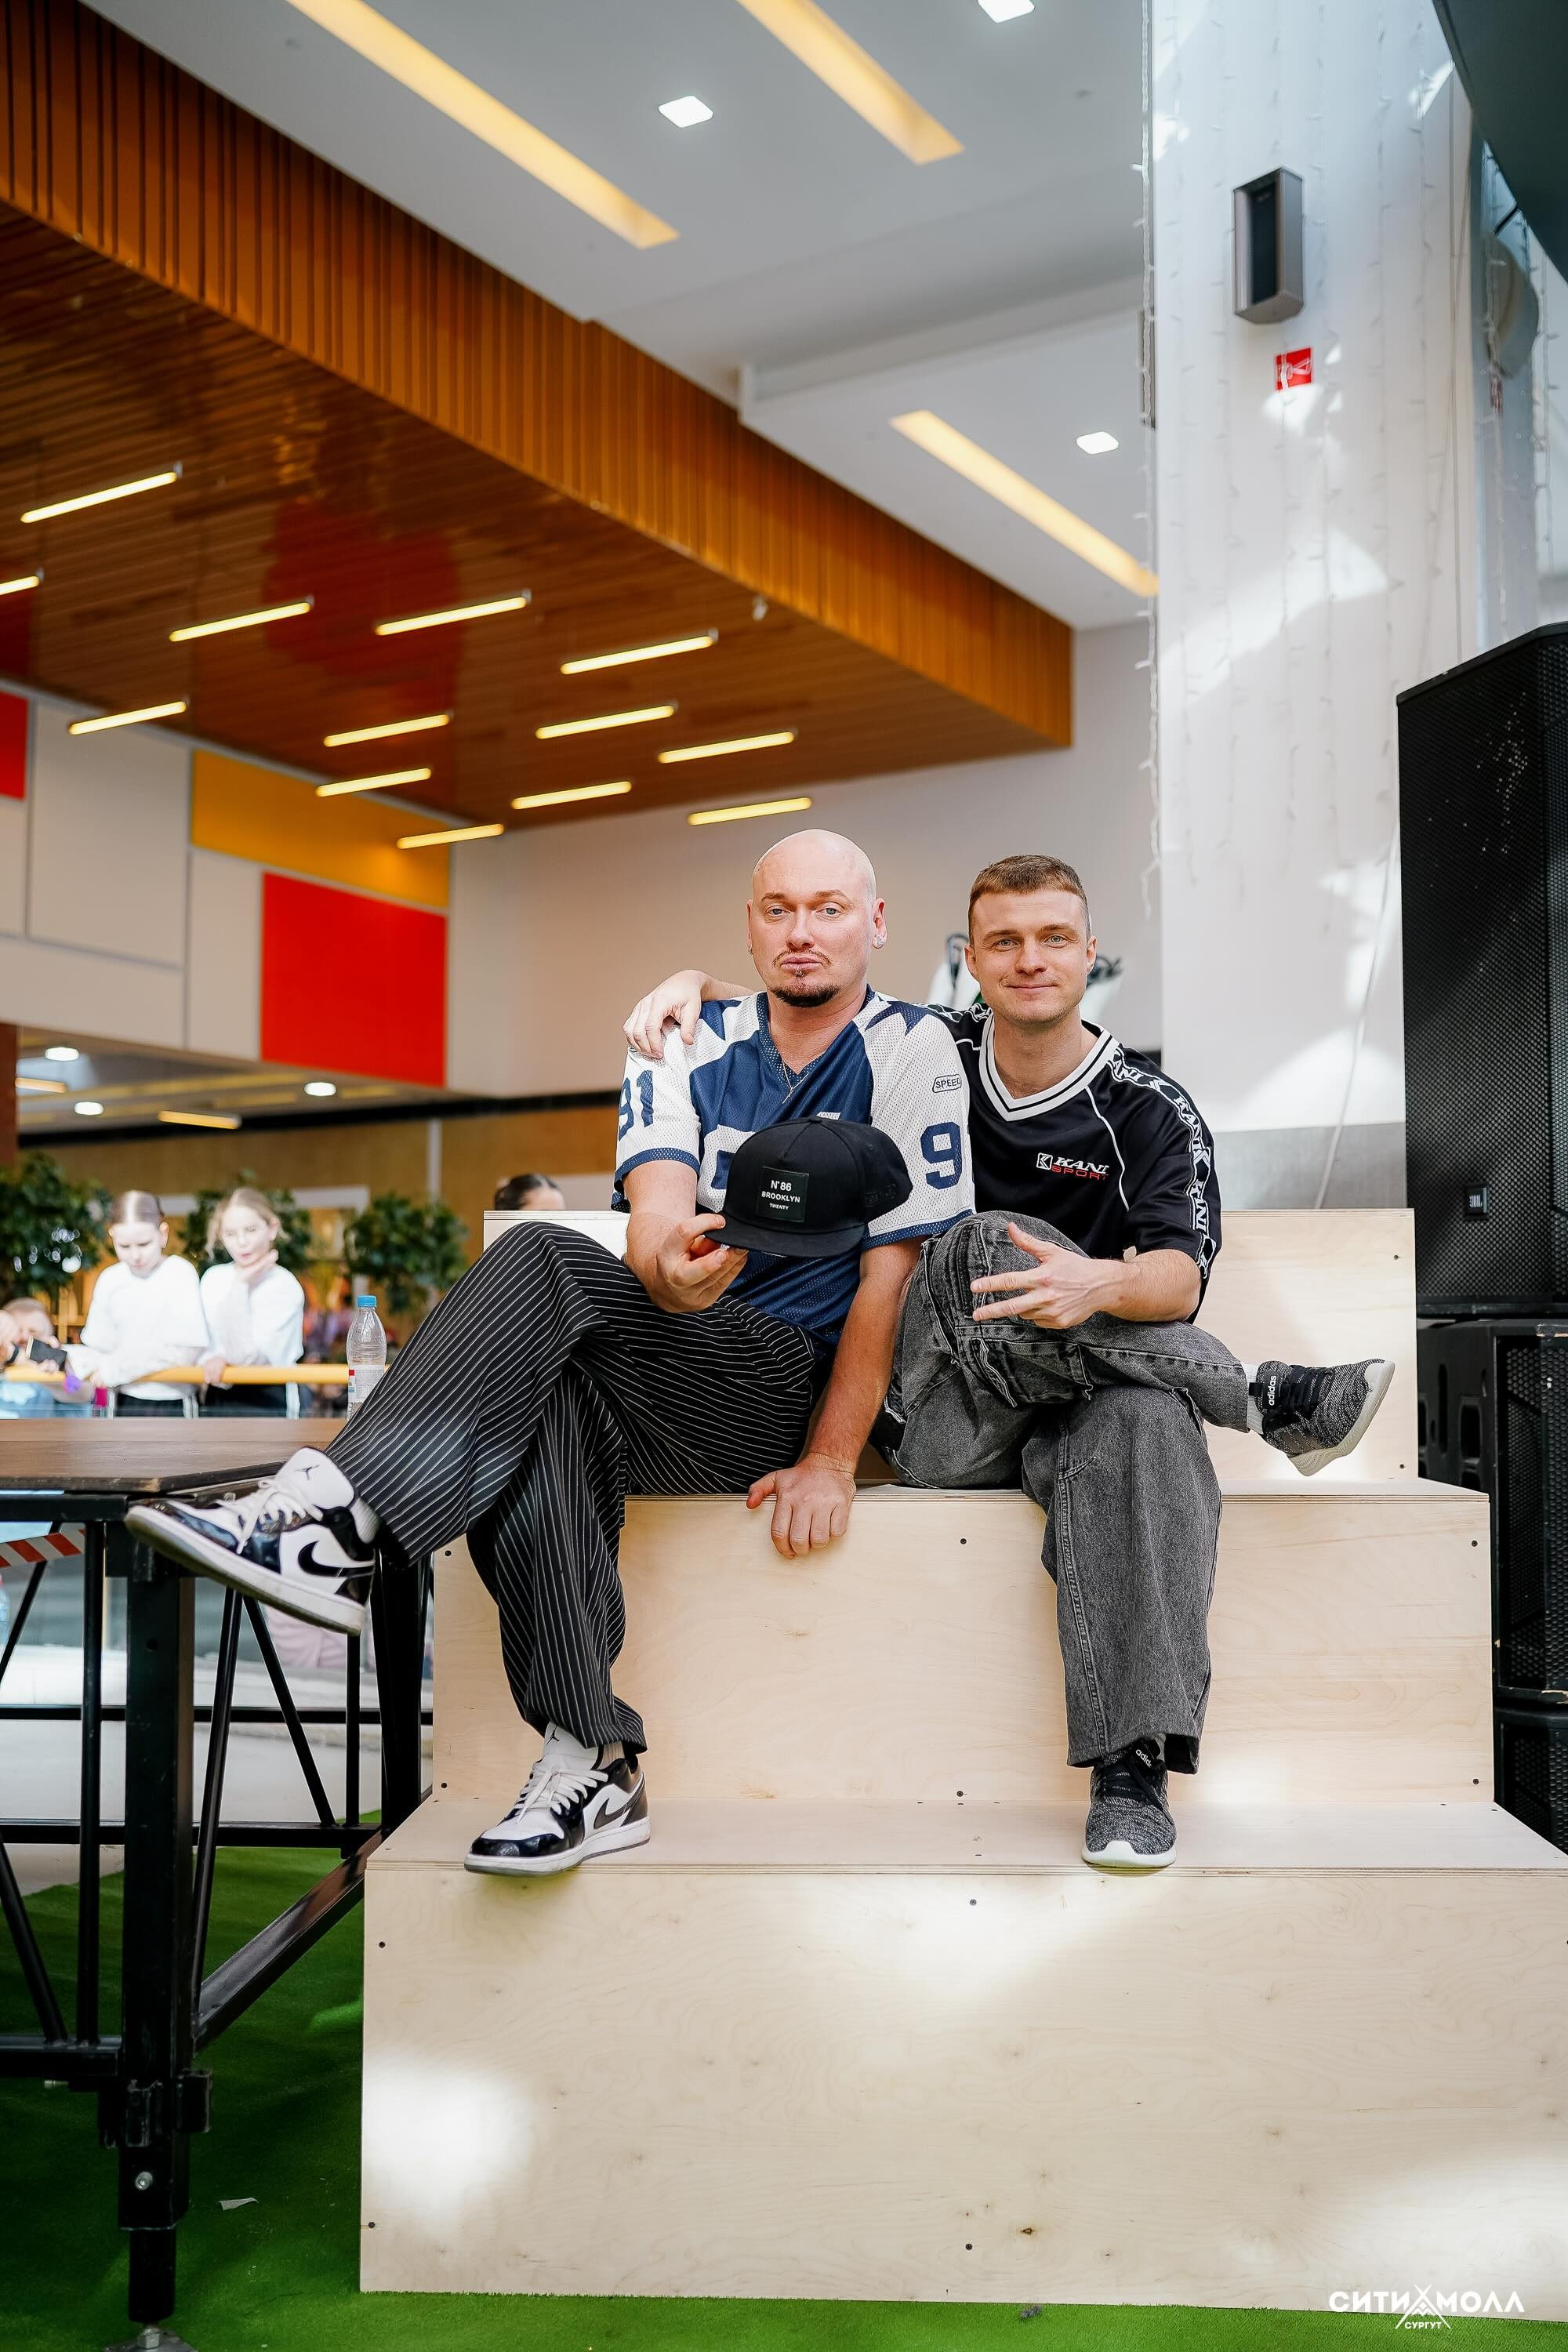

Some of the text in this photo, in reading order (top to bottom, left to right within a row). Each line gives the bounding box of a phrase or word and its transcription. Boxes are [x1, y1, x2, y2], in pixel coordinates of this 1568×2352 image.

[935, 1078, 960, 1088] SPEED
[920, 1121, 969, 1190] 9
[1053, 1156, 1109, 1174] KANI
[761, 1191, 800, 1203] BROOKLYN
[1267, 1375, 1277, 1406] adidas
[1135, 1749, 1152, 1768] adid
